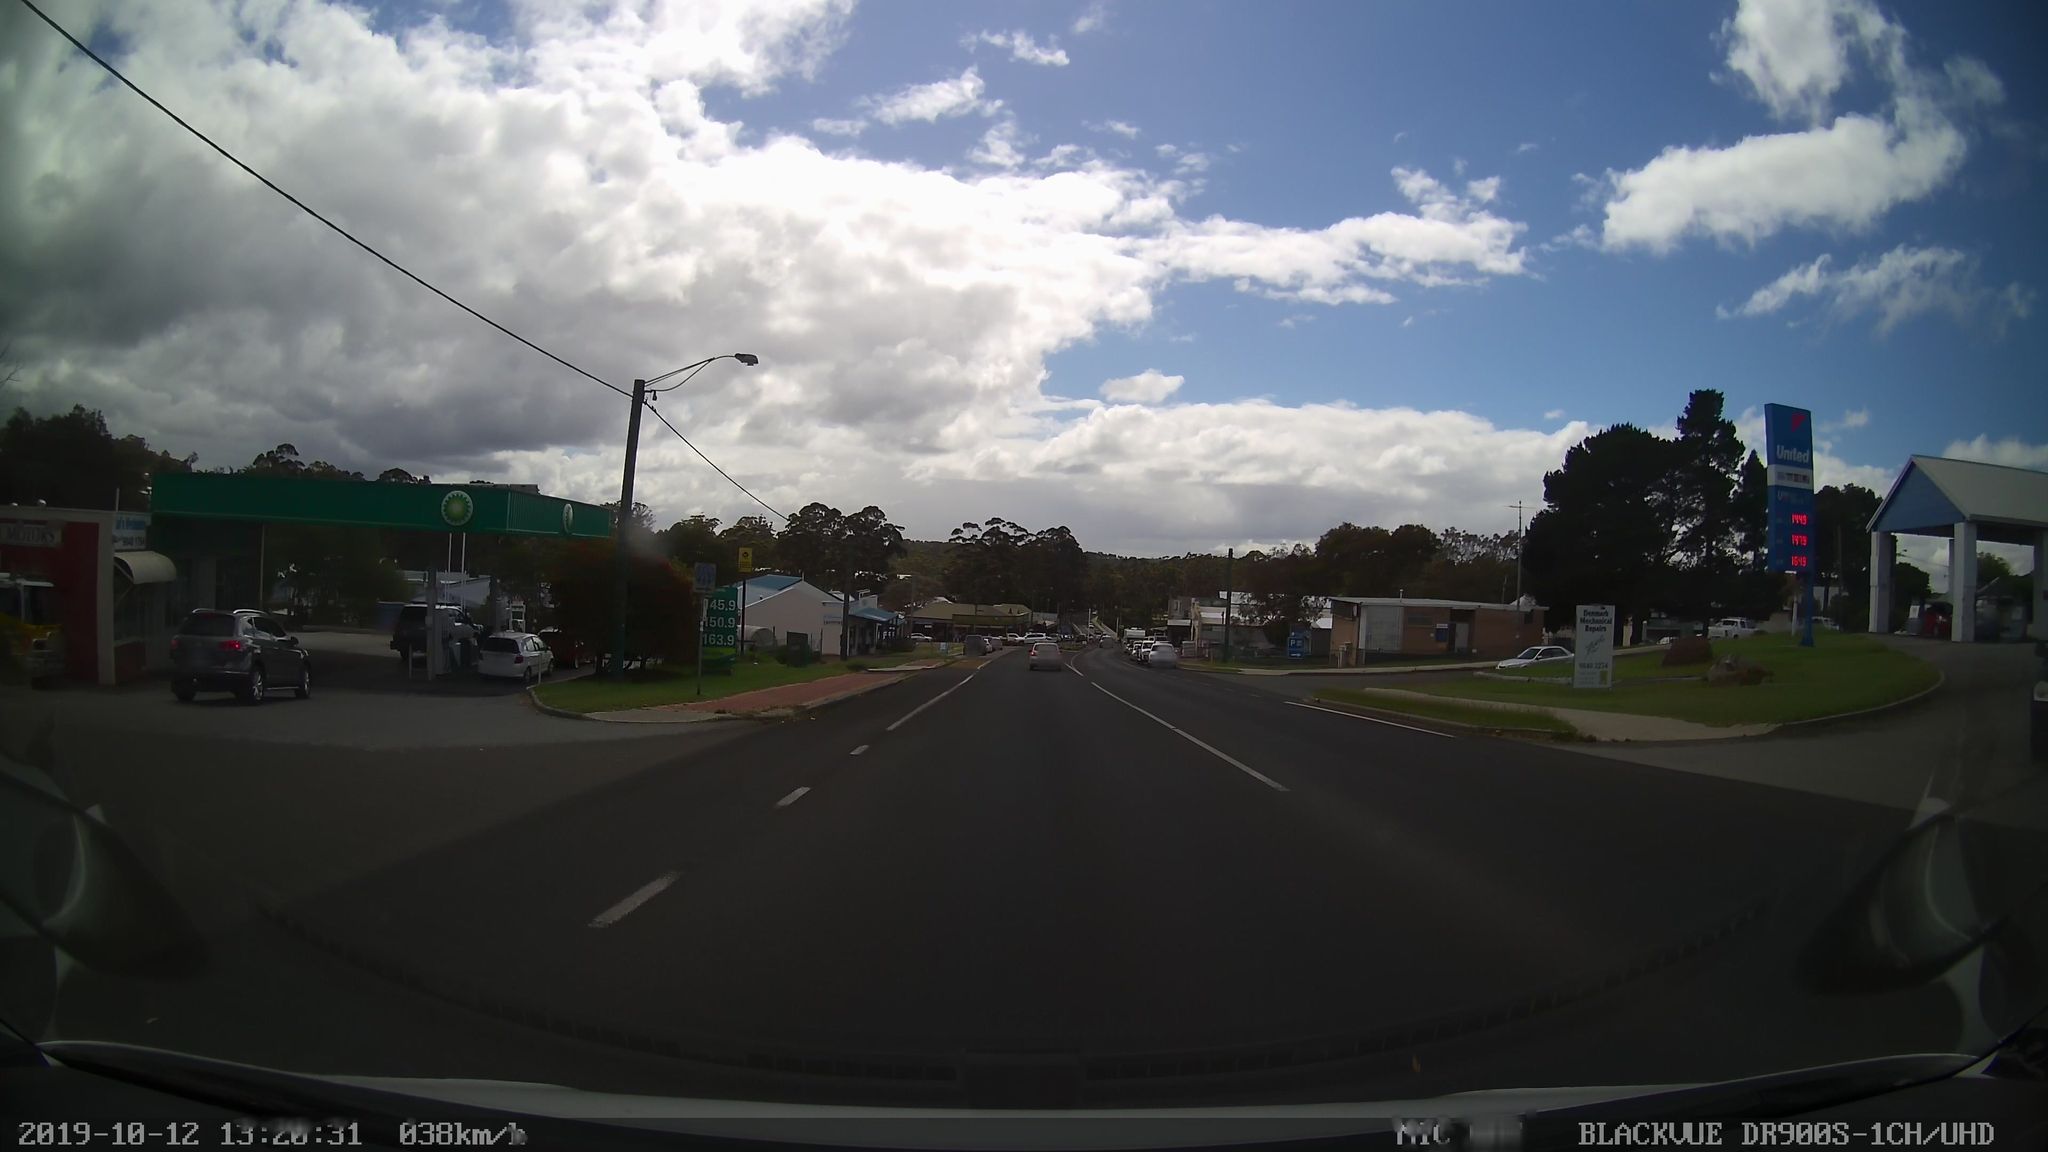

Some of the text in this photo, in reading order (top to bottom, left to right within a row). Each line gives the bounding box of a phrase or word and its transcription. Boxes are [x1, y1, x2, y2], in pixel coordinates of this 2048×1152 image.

[1776, 444, 1810, 465] United
[8, 526, 55, 543] MOTORS
[706, 599, 736, 611] 45.9
[704, 616, 736, 628] 150.9
[1580, 617, 1613, 625] Mechanical
[703, 633, 735, 646] 163.9
